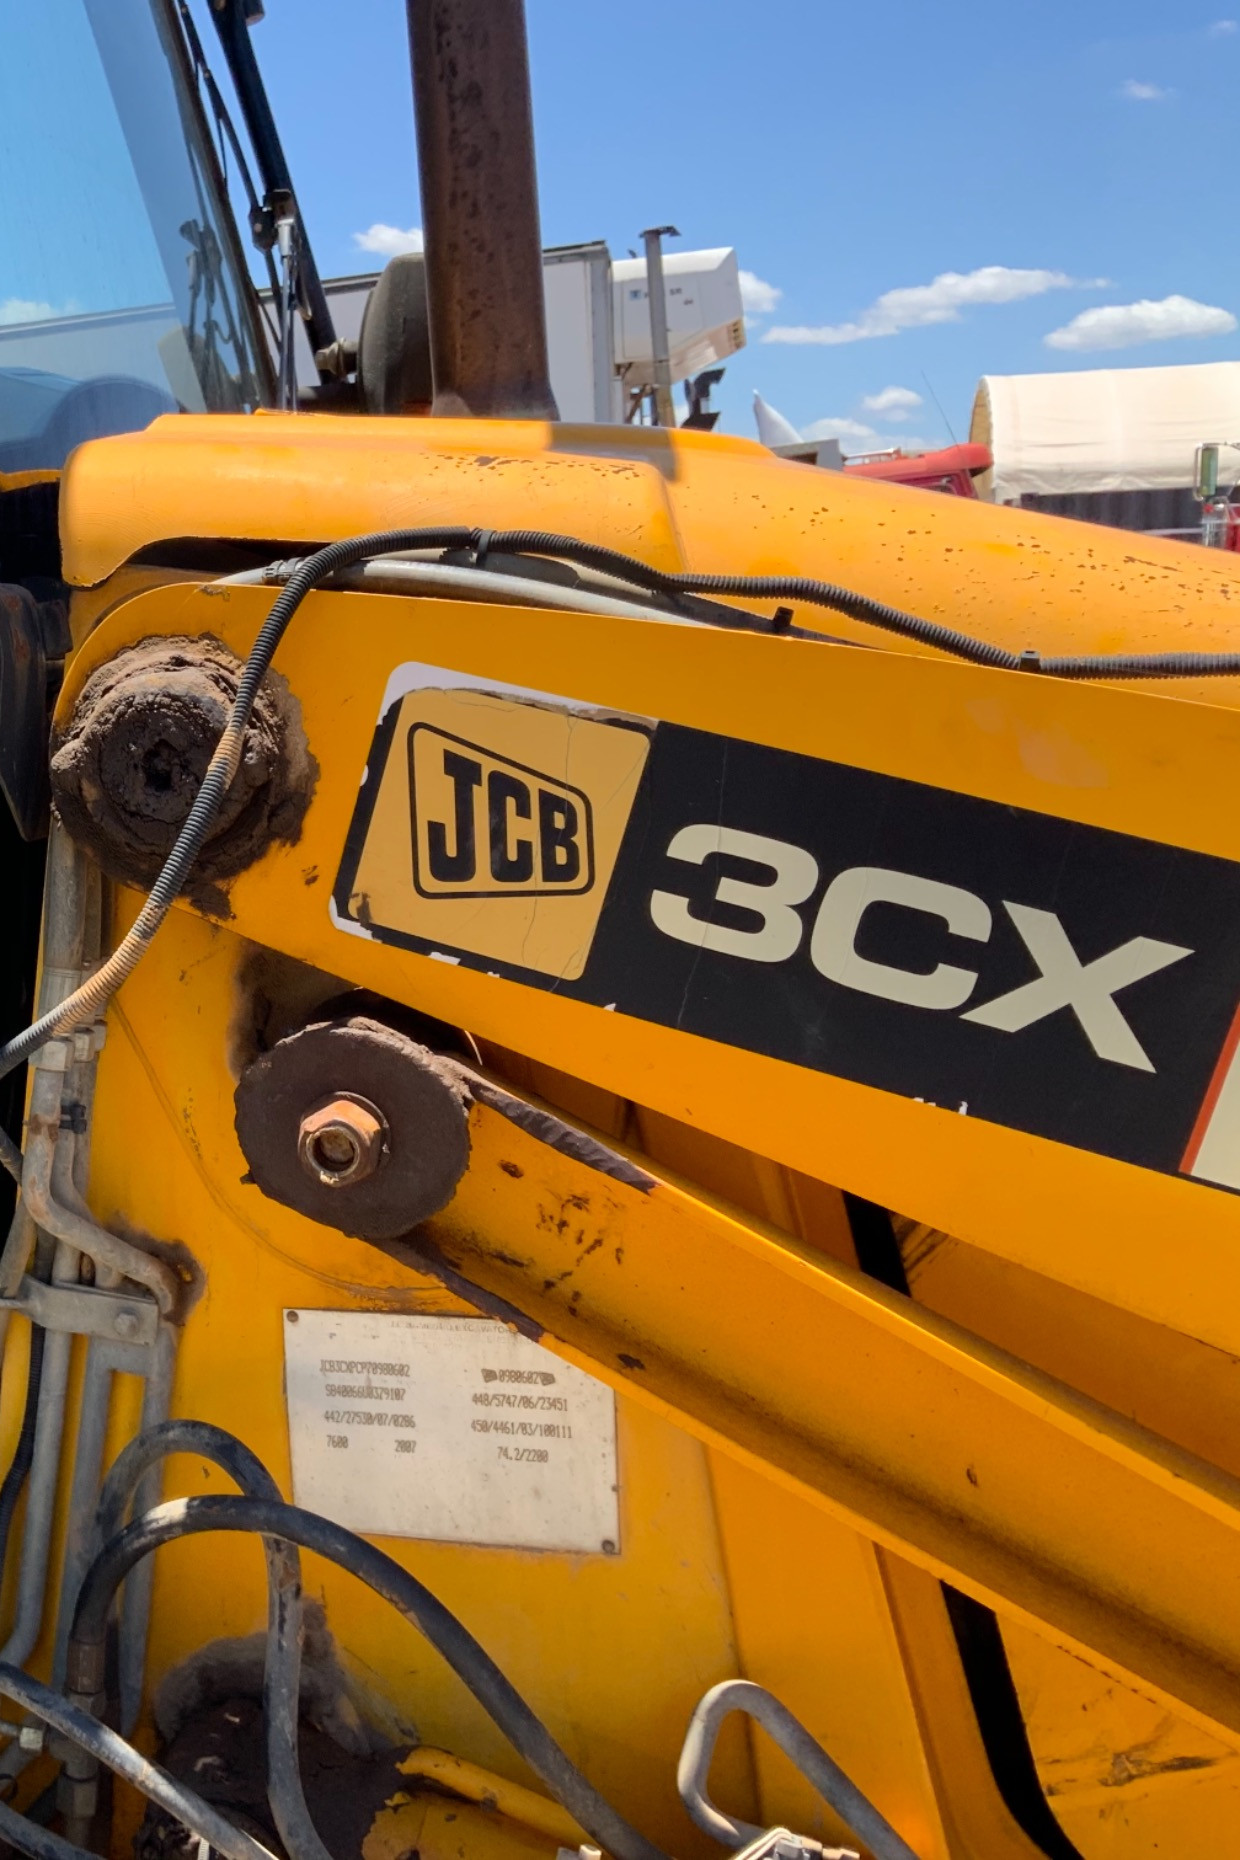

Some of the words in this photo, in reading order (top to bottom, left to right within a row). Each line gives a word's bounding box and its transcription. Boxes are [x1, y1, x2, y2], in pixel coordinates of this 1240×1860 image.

[426, 748, 581, 883] JCB
[649, 823, 1196, 1074] 3CX
[498, 1368, 540, 1384] 0980602
[394, 1439, 417, 1454] 2007
[496, 1446, 550, 1463] 74.2/2200
